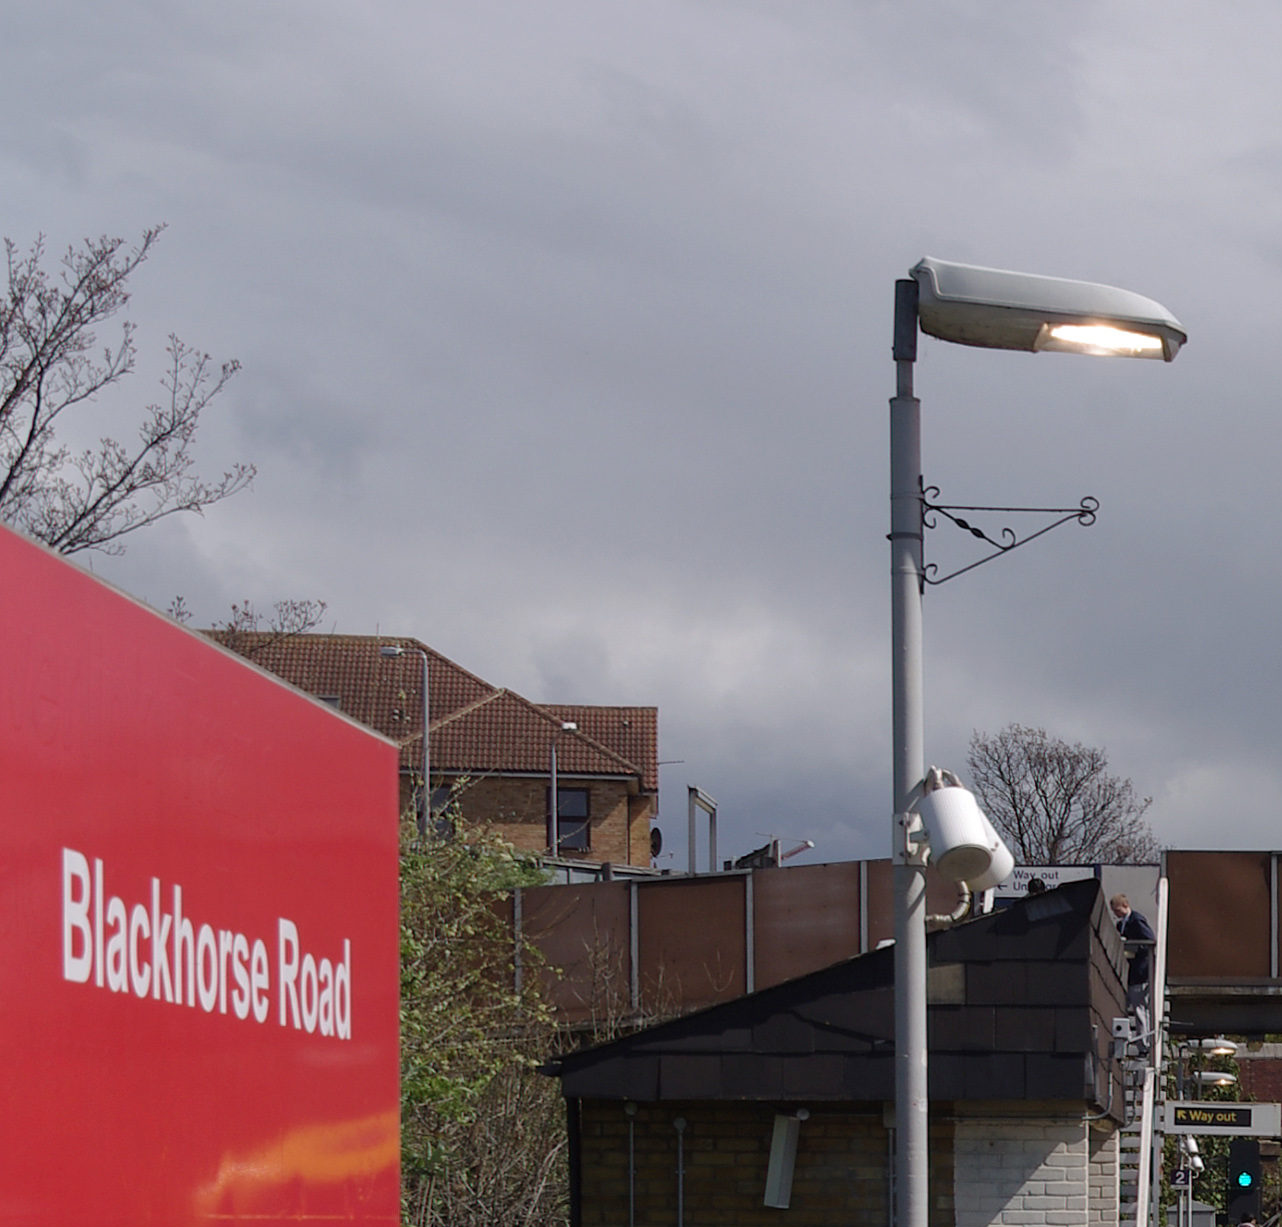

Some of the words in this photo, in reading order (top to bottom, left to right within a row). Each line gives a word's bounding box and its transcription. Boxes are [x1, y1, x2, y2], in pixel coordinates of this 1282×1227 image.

[1014, 870, 1035, 881] Way
[1041, 871, 1059, 879] out
[62, 847, 270, 1024] Blackhorse
[278, 917, 352, 1040] Road
[1189, 1109, 1214, 1124] Way
[1216, 1111, 1237, 1122] out
[1175, 1171, 1185, 1184] 2
